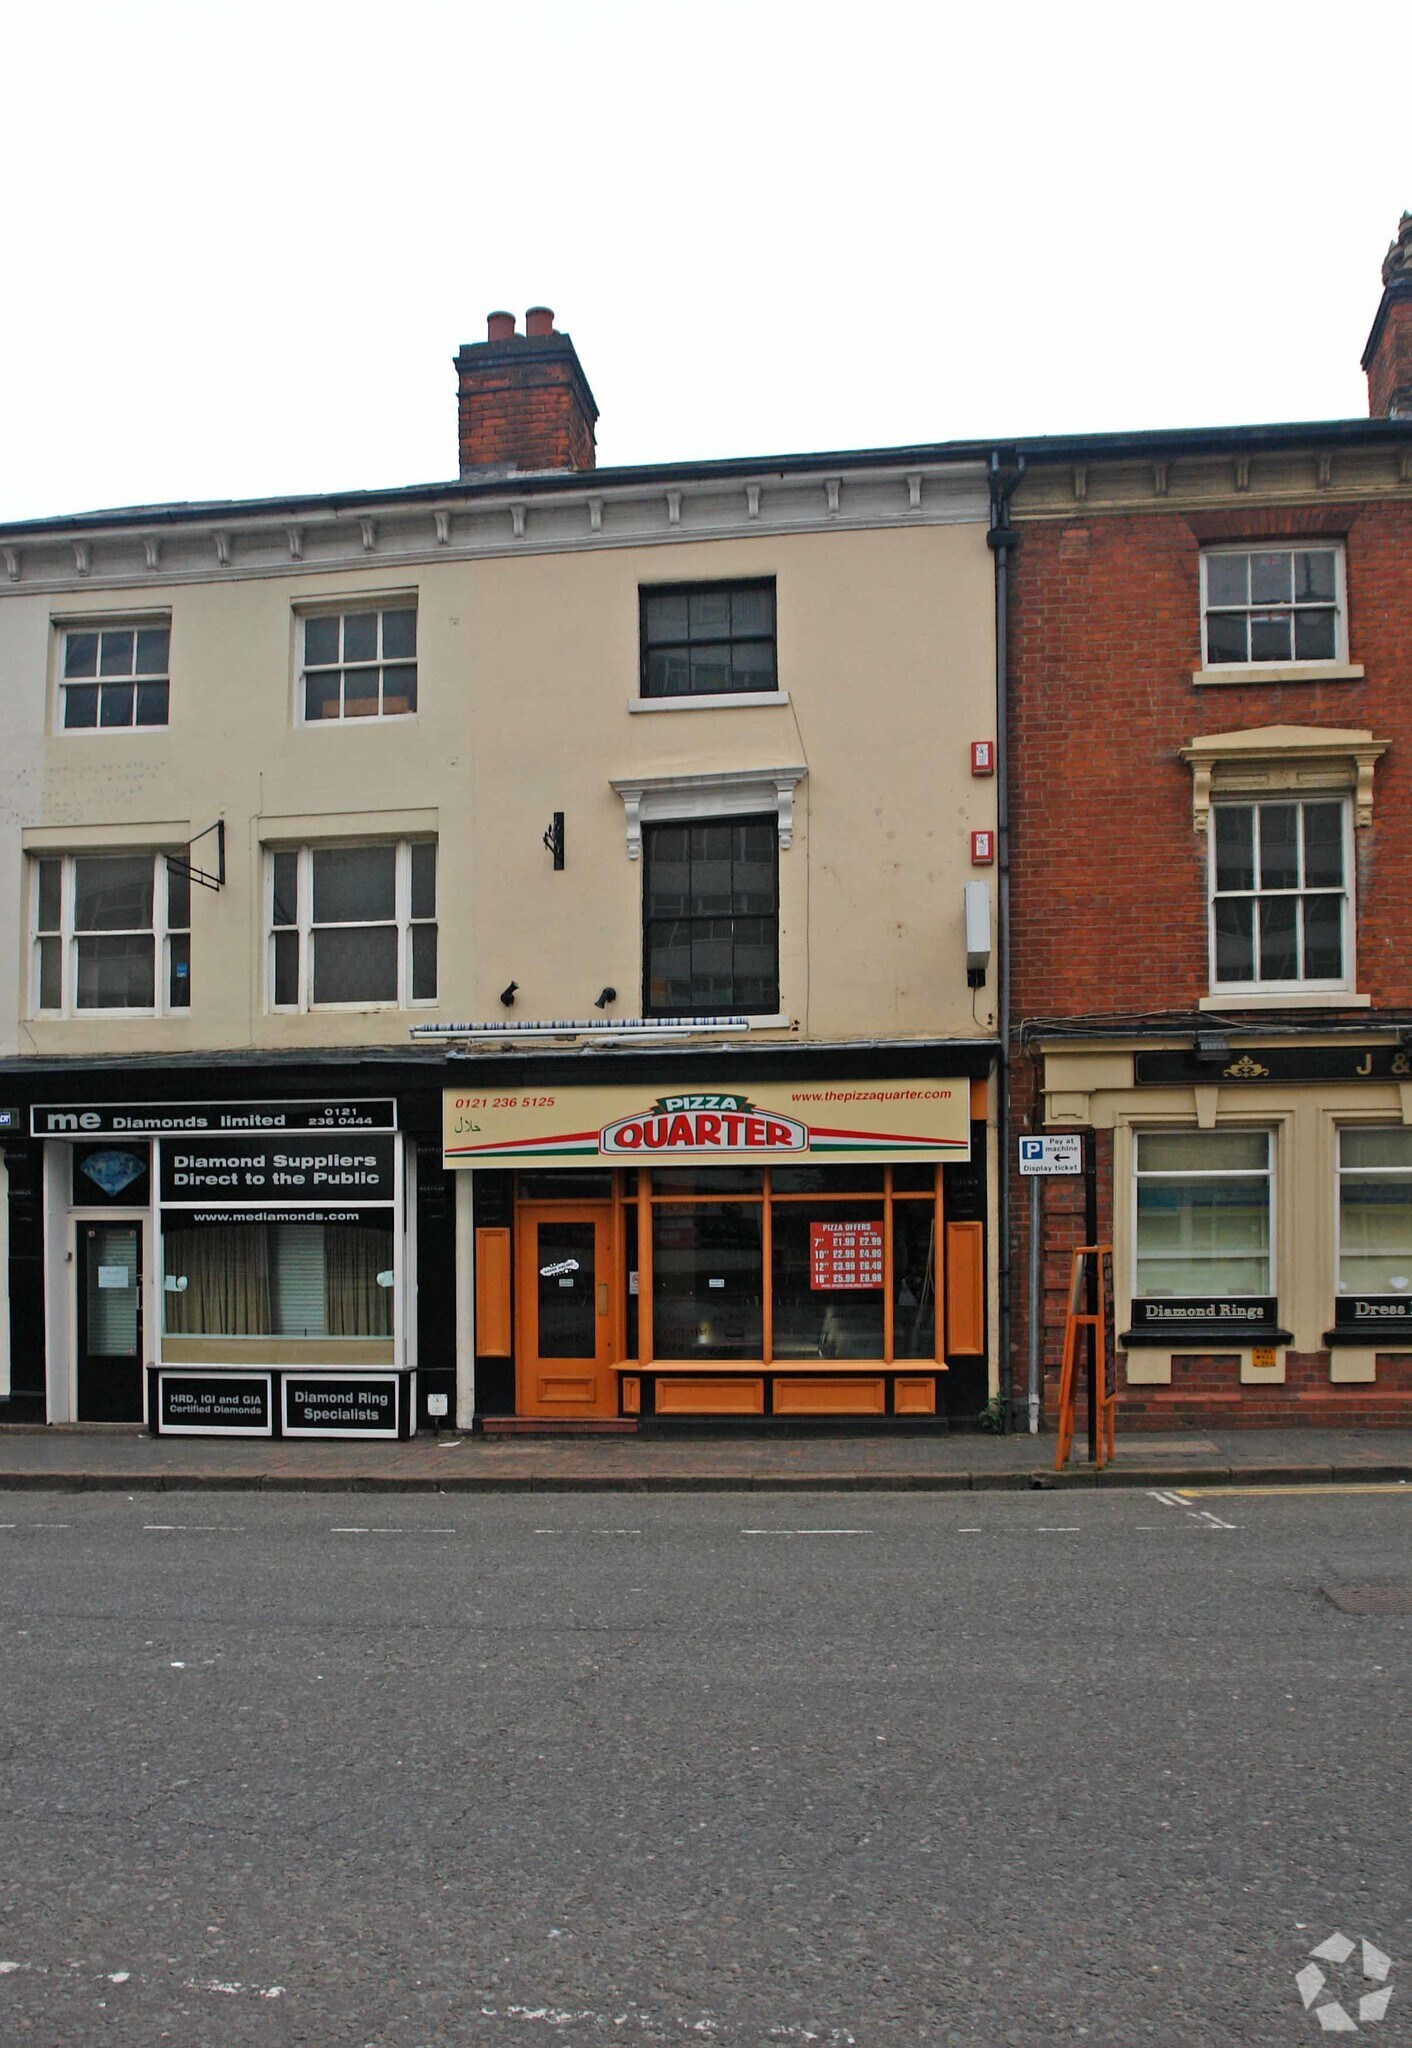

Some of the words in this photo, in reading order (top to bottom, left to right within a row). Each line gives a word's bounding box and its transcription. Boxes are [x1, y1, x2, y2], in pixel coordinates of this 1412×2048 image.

[1356, 1053, 1372, 1075] J
[455, 1098, 487, 1108] 0121
[492, 1097, 517, 1108] 236
[522, 1096, 556, 1107] 5125
[791, 1089, 952, 1103] www.thepizzaquarter.com
[665, 1096, 738, 1111] PIZZA
[324, 1108, 357, 1116] 0121
[47, 1112, 101, 1130] me
[112, 1116, 209, 1129] Diamonds
[220, 1114, 286, 1127] limited
[308, 1117, 334, 1126] 236
[338, 1117, 373, 1125] 0444
[454, 1116, 482, 1134] حلال
[614, 1115, 793, 1149] QUARTER
[1026, 1142, 1040, 1158] P
[174, 1155, 266, 1168] Diamond
[273, 1153, 377, 1169] Suppliers
[174, 1172, 238, 1185] Direct
[245, 1174, 265, 1185] to
[272, 1172, 305, 1185] the
[313, 1171, 380, 1184] Public
[193, 1211, 360, 1222] www.mediamonds.com
[822, 1223, 843, 1232] PIZZA
[845, 1223, 871, 1231] OFFERS
[832, 1237, 855, 1247] £1.99
[860, 1236, 882, 1246] £2.99
[833, 1249, 855, 1258] £2.99
[860, 1249, 882, 1258] £4.99
[1146, 1304, 1216, 1317] Diamond
[1220, 1303, 1264, 1320] Rings
[1355, 1302, 1406, 1316] Dress
[170, 1394, 198, 1404] HRD,
[201, 1395, 216, 1404] IGI
[219, 1395, 239, 1405] and
[242, 1395, 262, 1405] GIA
[294, 1391, 354, 1404] Diamond
[358, 1392, 389, 1406] Ring
[170, 1404, 211, 1413] Certified
[213, 1405, 262, 1414] Diamonds
[304, 1408, 379, 1422] Specialists
